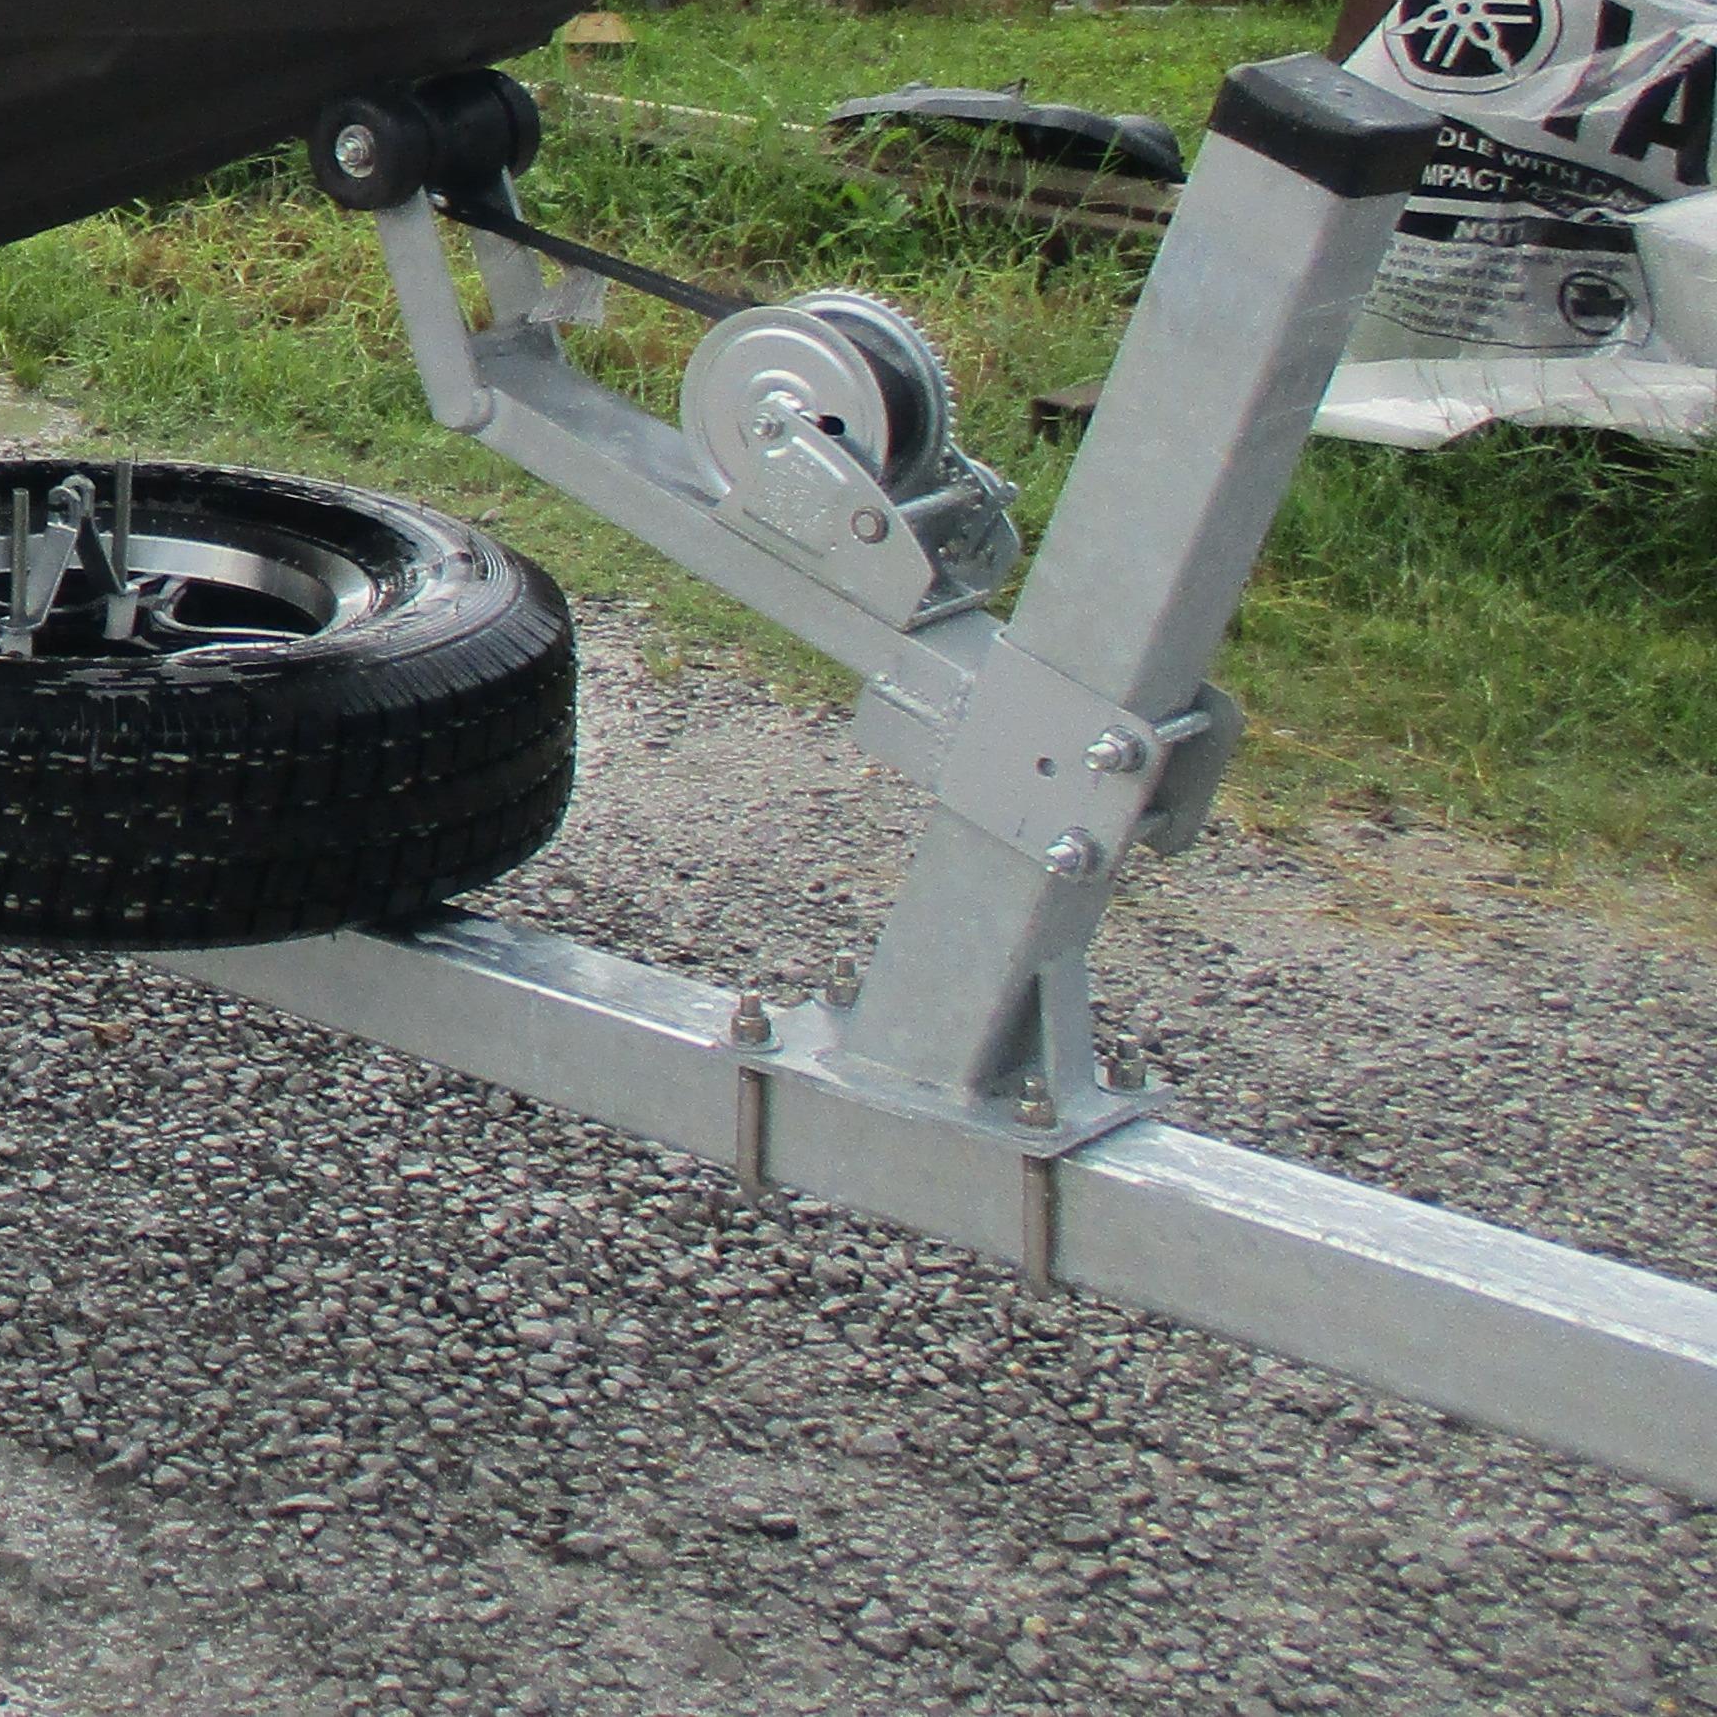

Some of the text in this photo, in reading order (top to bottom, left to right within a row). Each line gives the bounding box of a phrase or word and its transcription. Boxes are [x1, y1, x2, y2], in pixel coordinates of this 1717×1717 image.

[1436, 126, 1496, 158] DLE
[1501, 151, 1580, 185] WITH
[1421, 163, 1514, 193] MPACT
